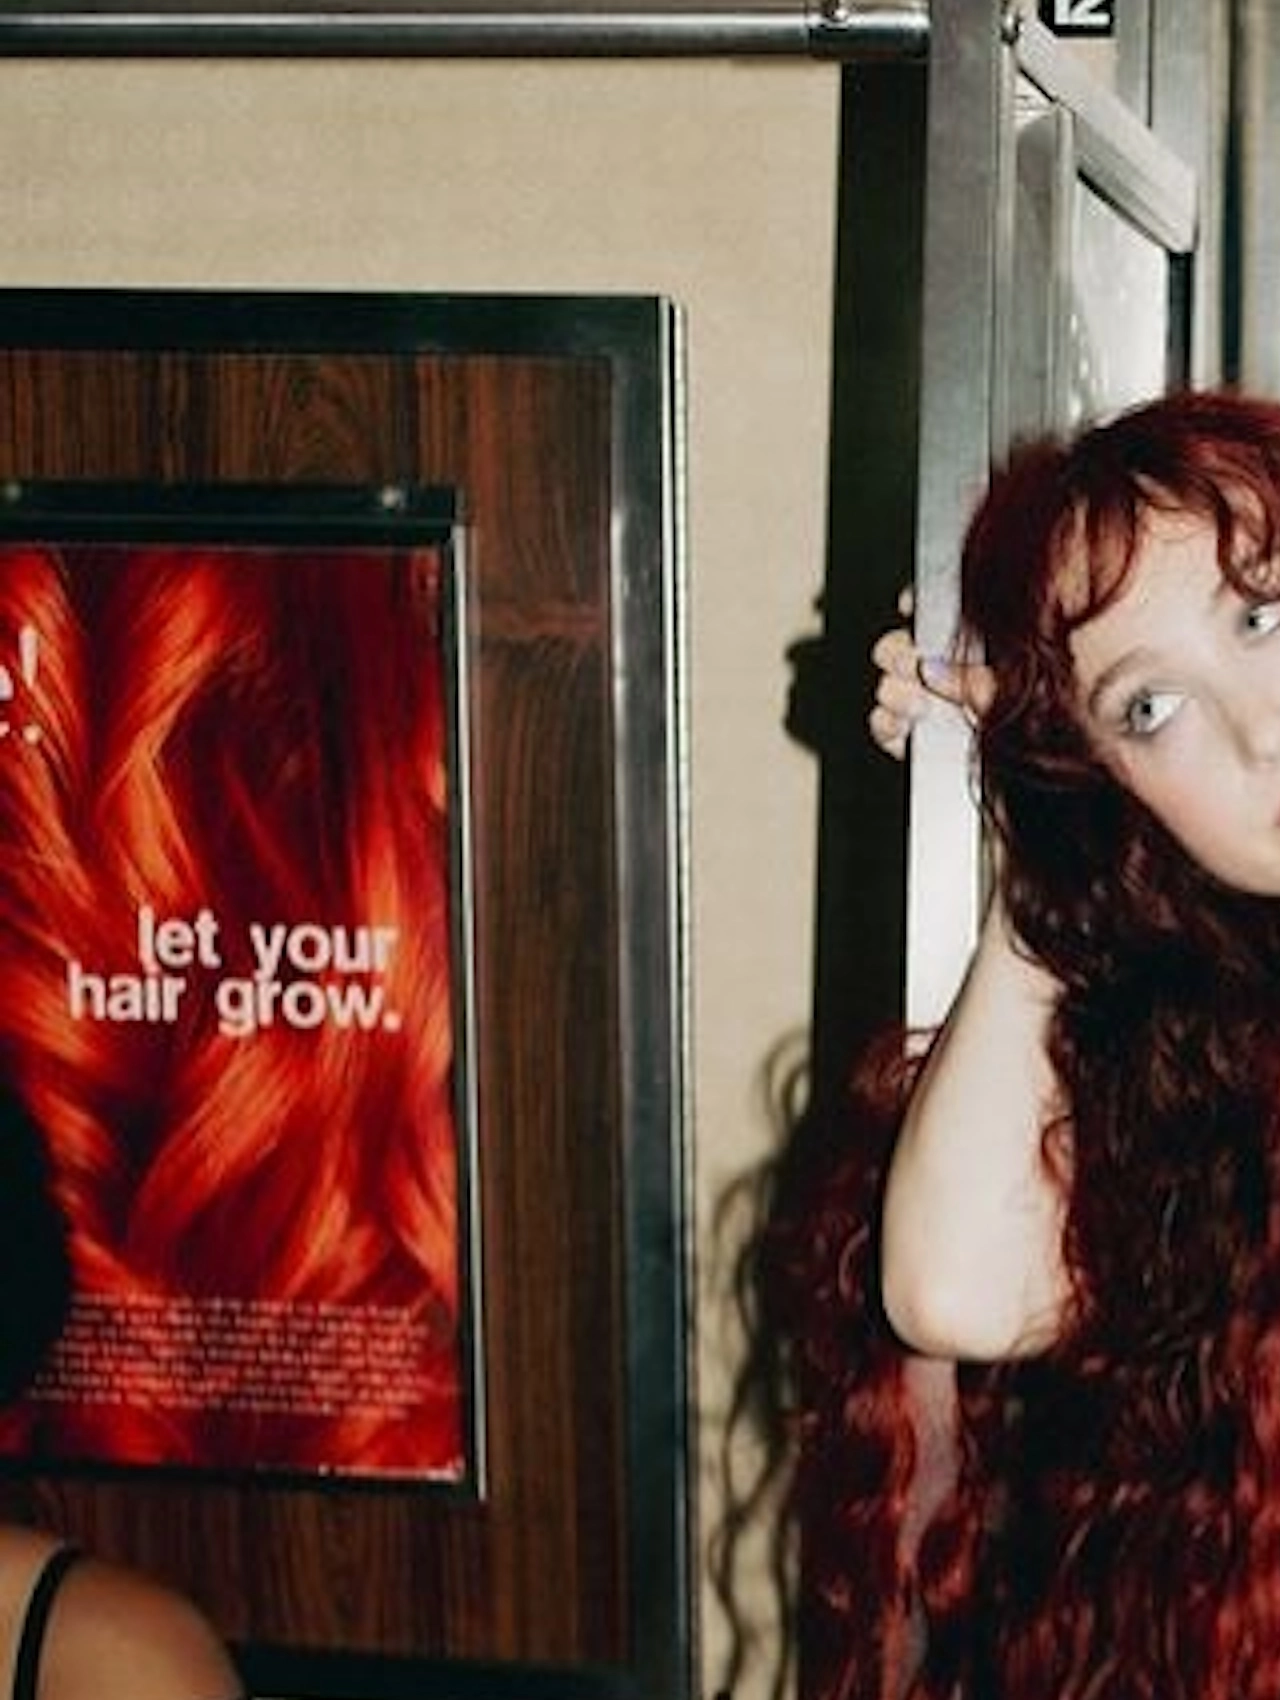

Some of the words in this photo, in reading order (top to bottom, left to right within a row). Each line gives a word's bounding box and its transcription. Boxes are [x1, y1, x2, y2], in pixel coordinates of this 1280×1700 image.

[138, 906, 221, 971] let
[250, 922, 398, 980] your
[67, 961, 186, 1022] hair
[215, 977, 400, 1037] grow.
